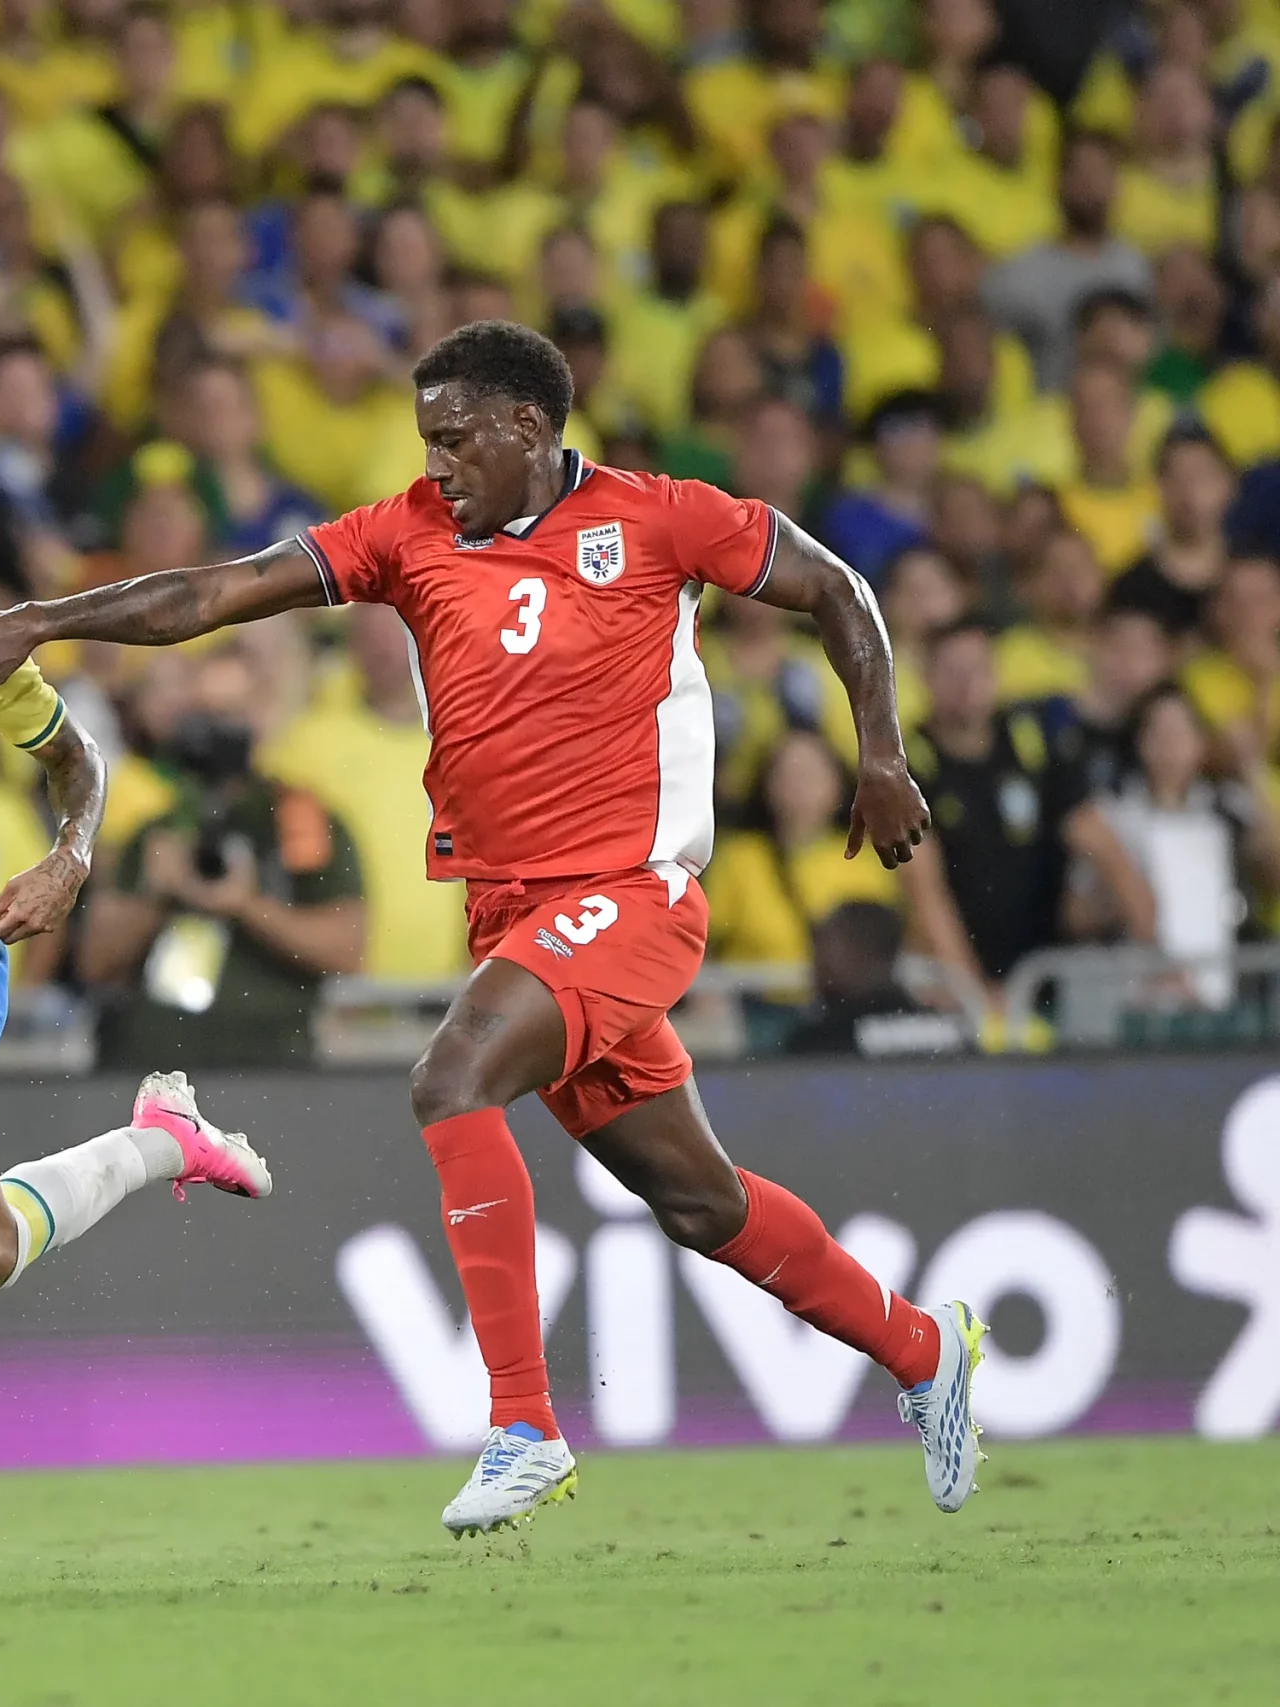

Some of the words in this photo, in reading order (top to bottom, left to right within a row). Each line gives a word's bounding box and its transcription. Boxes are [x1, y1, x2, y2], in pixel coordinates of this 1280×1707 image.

[581, 525, 618, 540] PANAMÁ
[499, 576, 549, 655] 3
[553, 892, 620, 946] 3
[537, 927, 574, 957] Reebok
